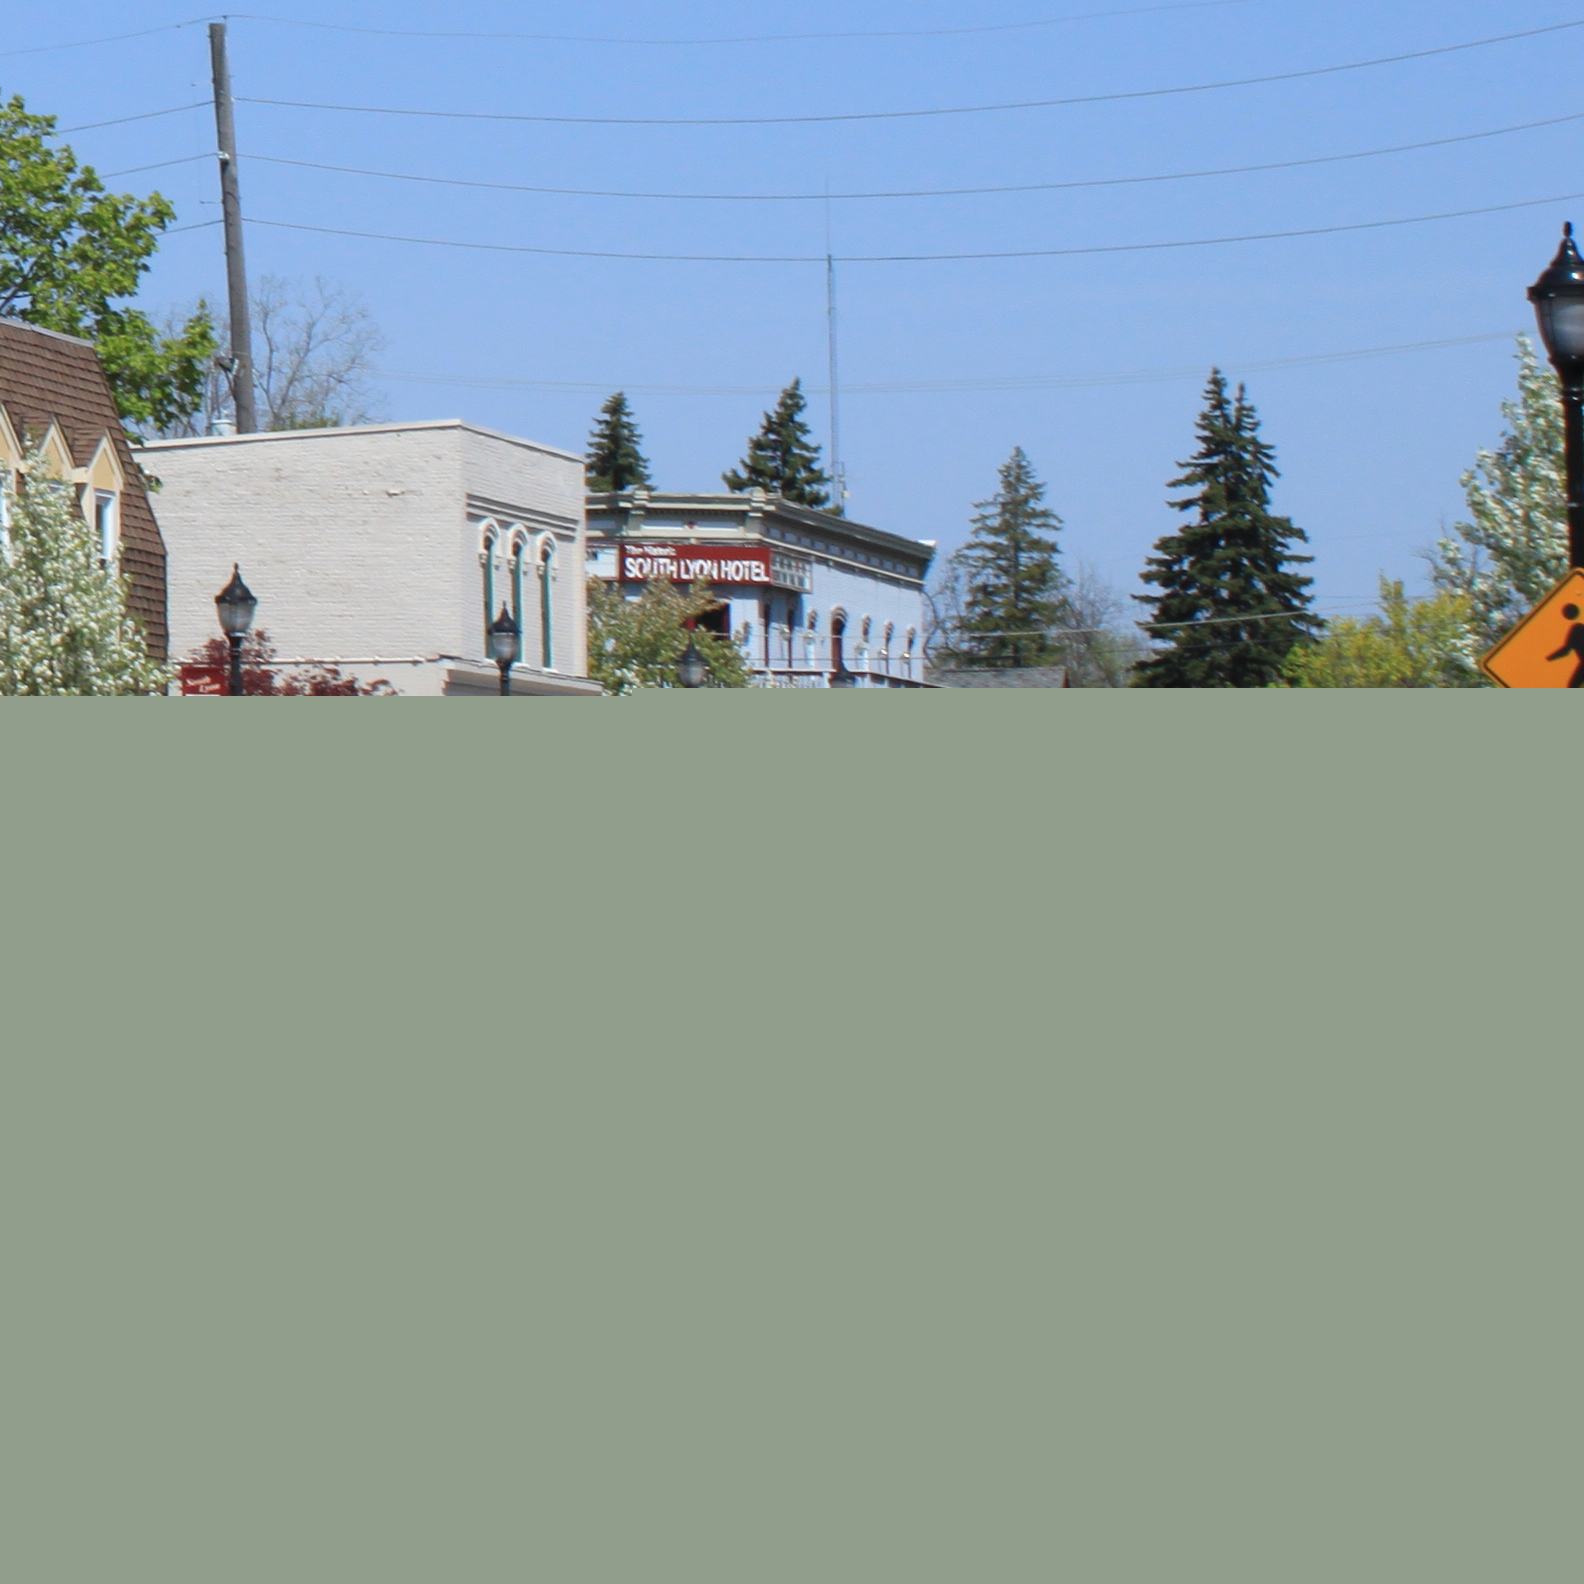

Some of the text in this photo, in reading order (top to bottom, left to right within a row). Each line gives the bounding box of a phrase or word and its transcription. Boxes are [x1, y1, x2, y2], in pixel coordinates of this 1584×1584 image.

[624, 556, 770, 583] SOUTH LYON HOTEL
